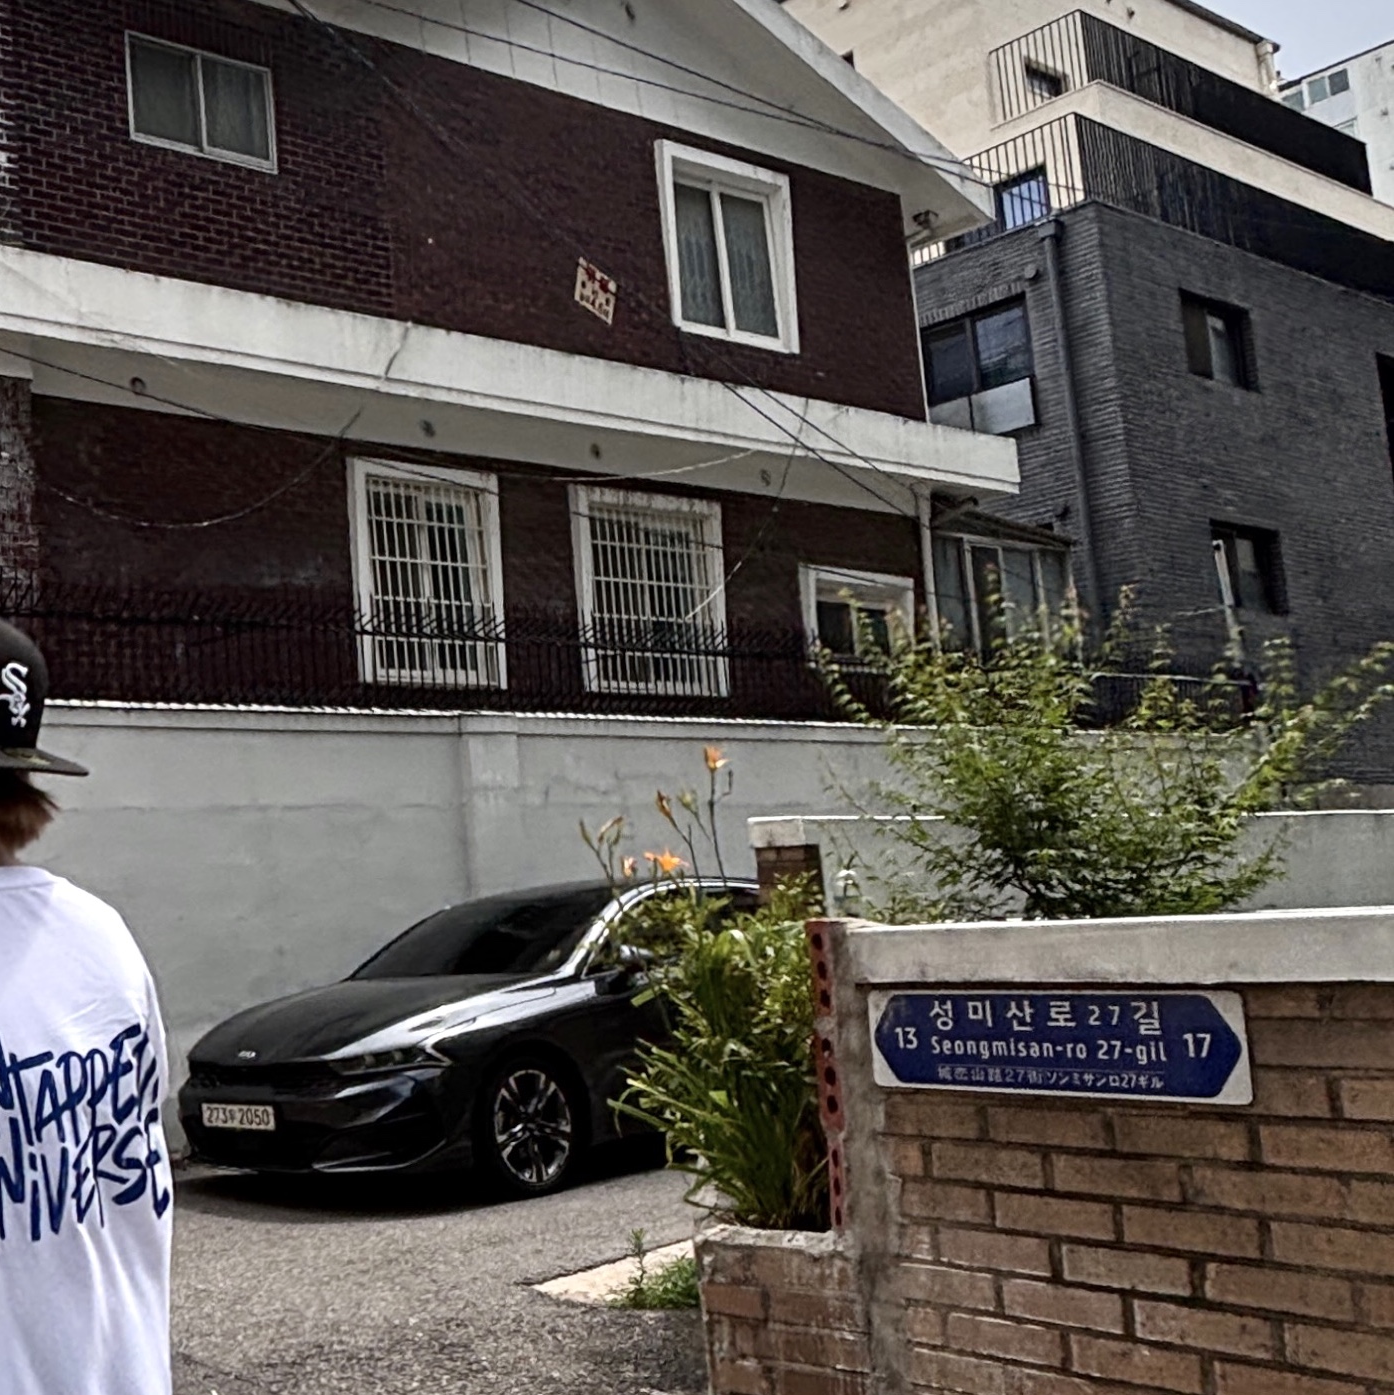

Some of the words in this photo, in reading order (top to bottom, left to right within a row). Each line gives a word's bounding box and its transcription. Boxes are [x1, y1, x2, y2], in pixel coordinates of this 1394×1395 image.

[894, 1027, 918, 1049] 13
[1183, 1033, 1211, 1058] 17
[931, 1035, 1087, 1060] Seongmisan-ro
[1097, 1040, 1167, 1065] 27-gil
[238, 1107, 270, 1126] 2050
